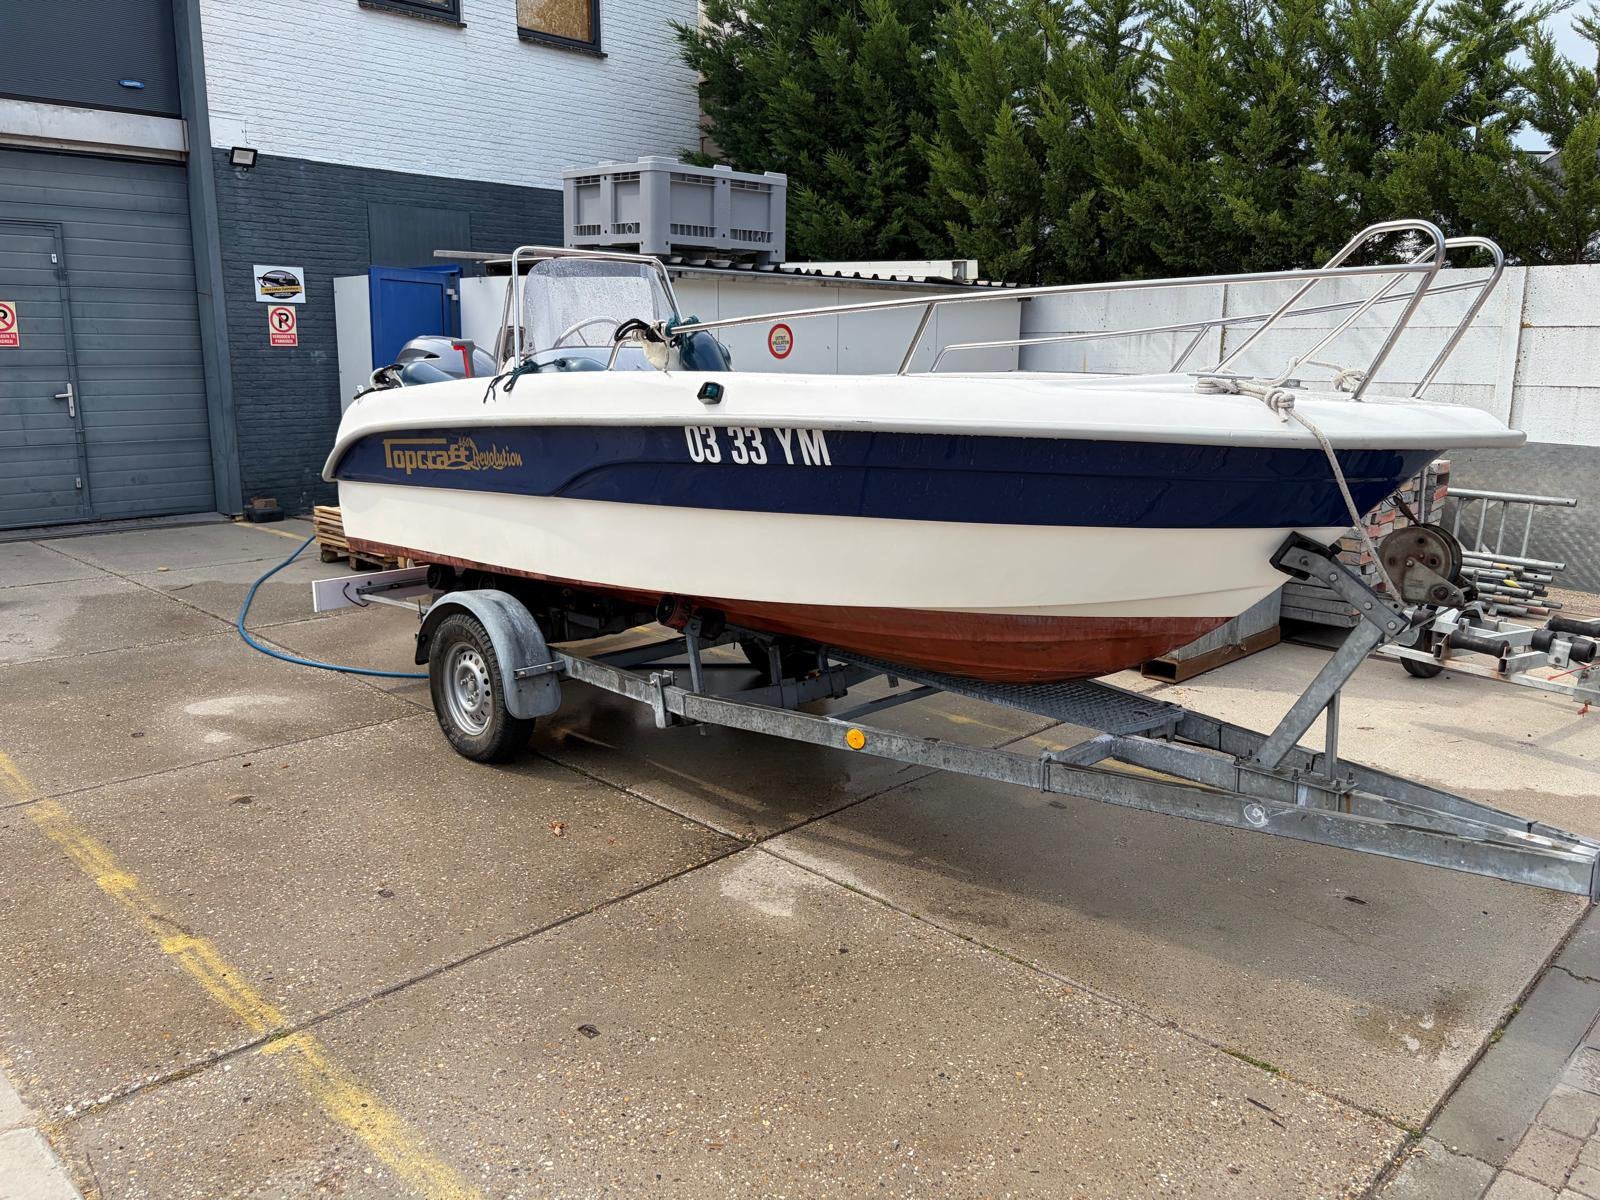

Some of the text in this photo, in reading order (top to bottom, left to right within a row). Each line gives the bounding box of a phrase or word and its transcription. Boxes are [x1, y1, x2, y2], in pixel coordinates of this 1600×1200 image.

[382, 438, 469, 475] Topcraft
[684, 425, 832, 466] 03 33 YM
